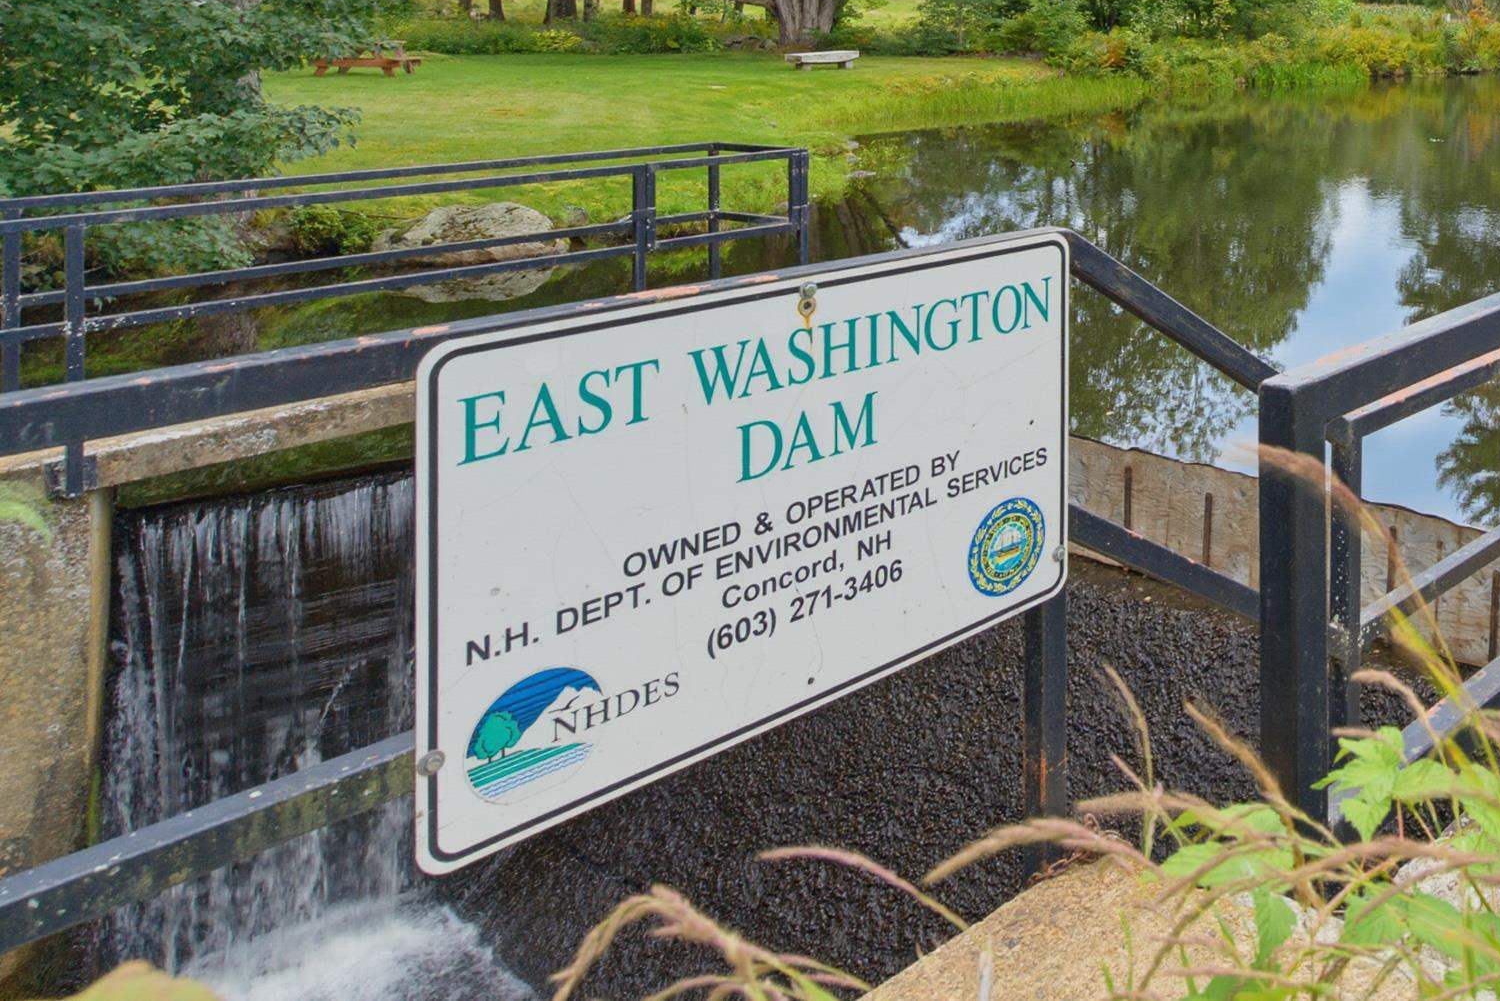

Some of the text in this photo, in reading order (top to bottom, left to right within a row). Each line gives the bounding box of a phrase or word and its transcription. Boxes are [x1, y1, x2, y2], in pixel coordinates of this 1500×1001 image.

[456, 276, 1052, 466] EAST WASHINGTON
[736, 391, 879, 483] DAM
[466, 622, 539, 666] N.H.
[555, 580, 651, 636] DEPT.
[662, 562, 704, 597] OF
[716, 490, 938, 579] ENVIRONMENTAL
[947, 447, 1048, 498] SERVICES
[623, 450, 961, 578] OWNED & OPERATED BY
[707, 559, 903, 659] (603) 271-3406
[722, 531, 893, 610] Concord, NH
[551, 672, 680, 742] NHDES
